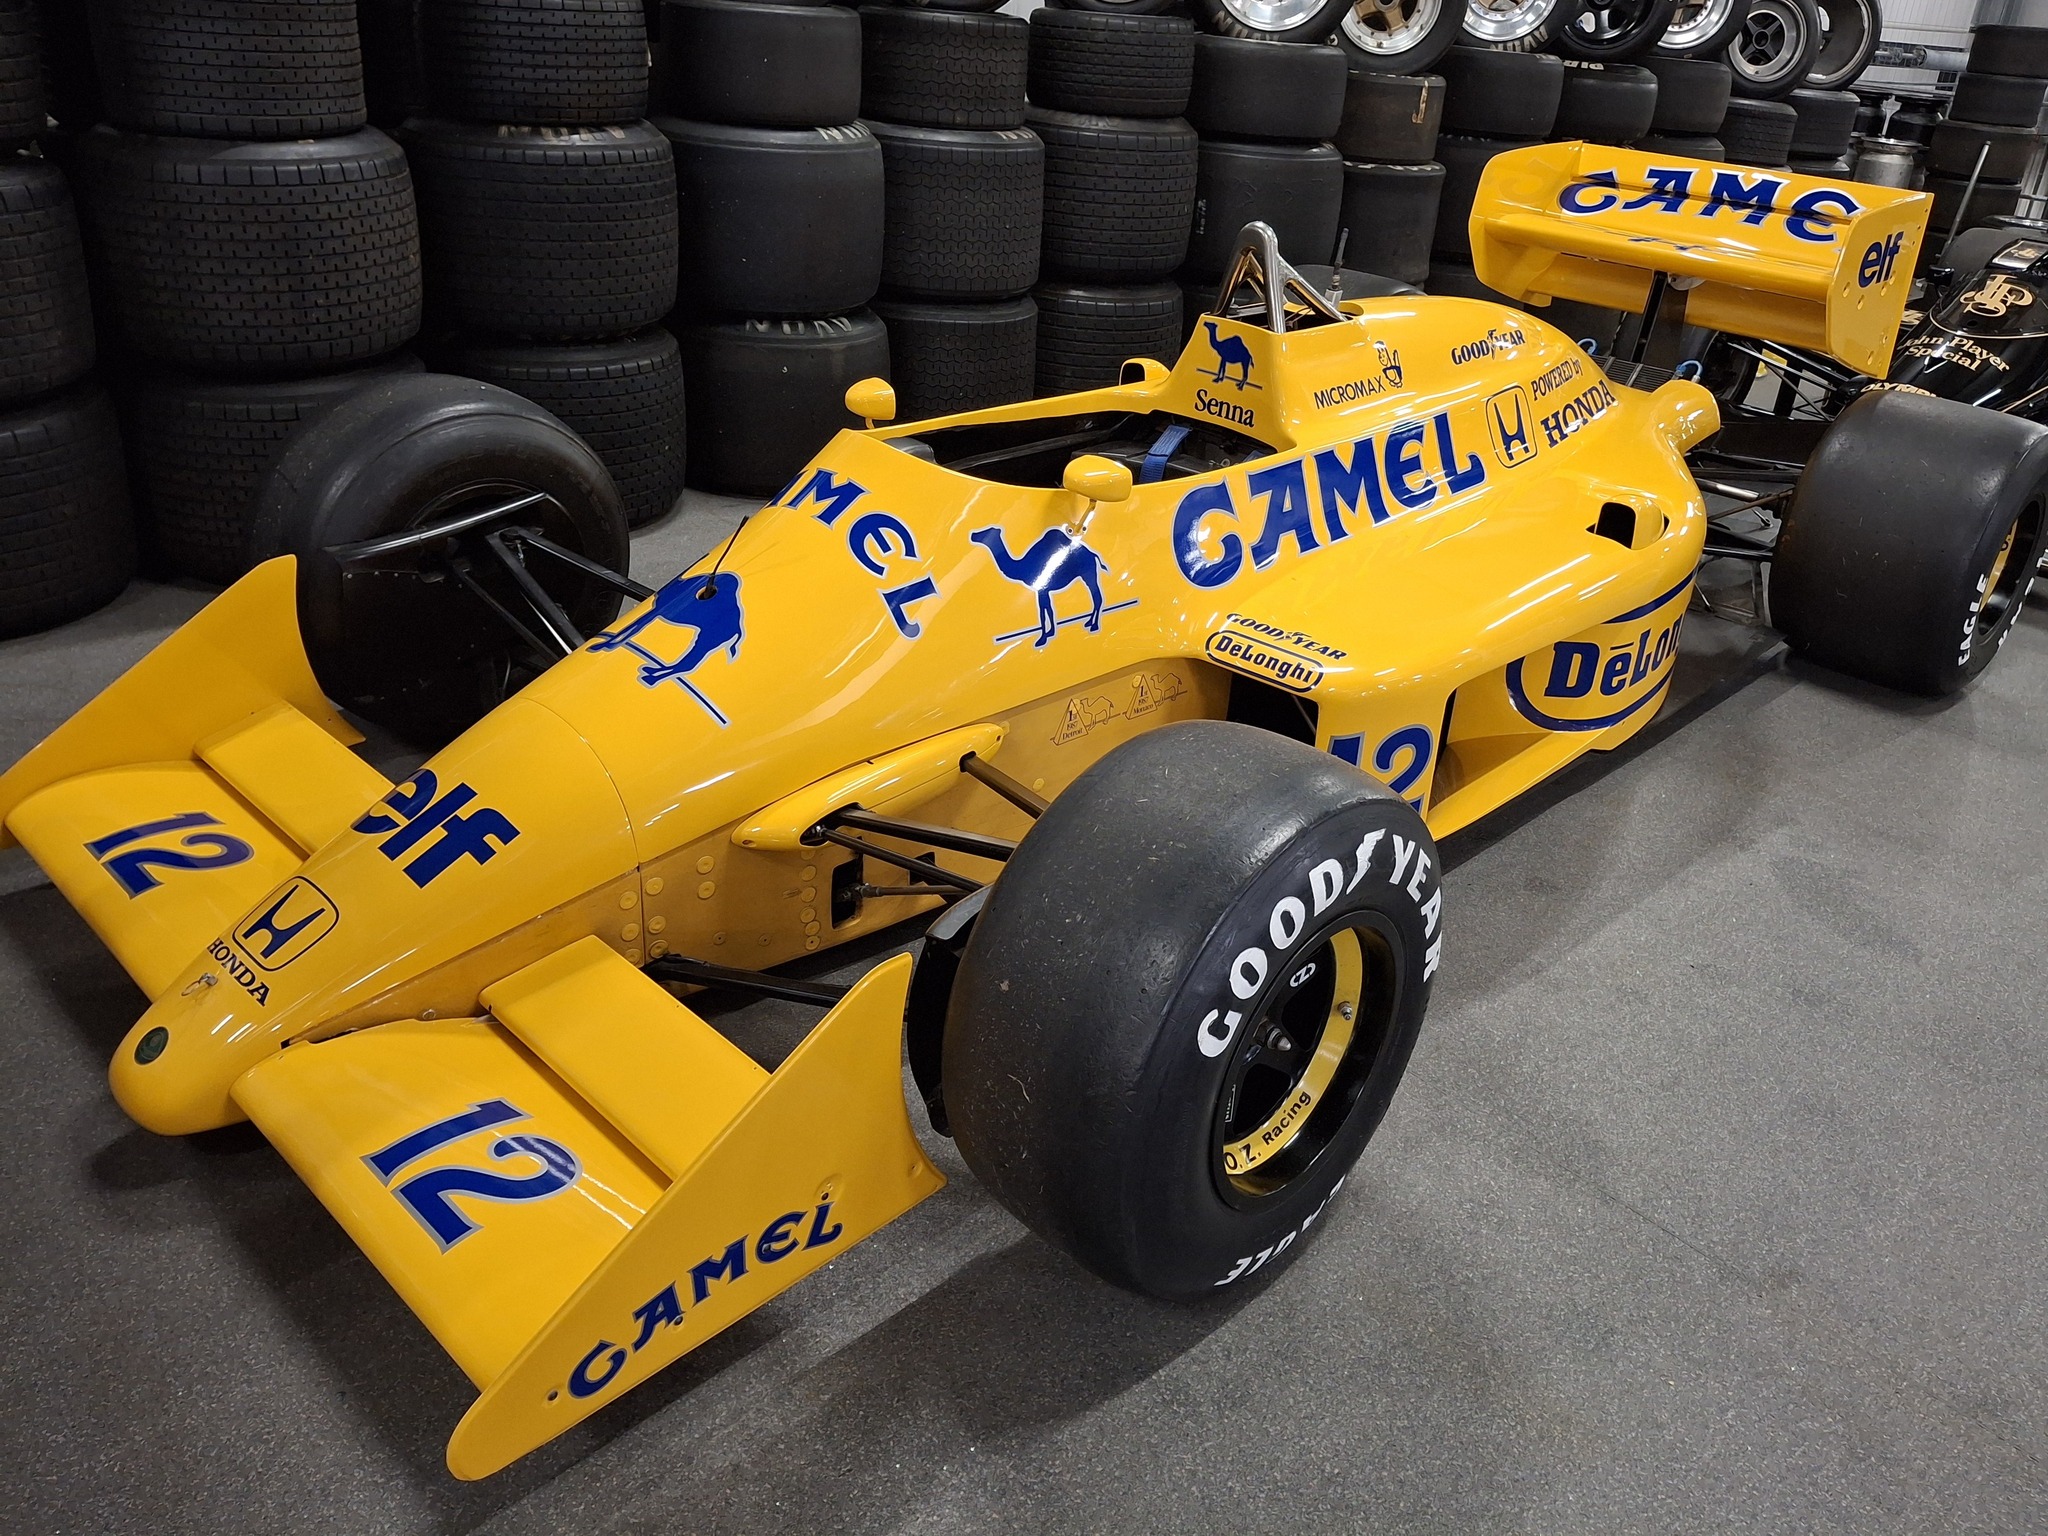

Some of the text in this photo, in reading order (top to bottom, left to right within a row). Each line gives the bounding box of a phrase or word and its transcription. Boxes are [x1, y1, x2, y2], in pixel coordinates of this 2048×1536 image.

[1558, 166, 1864, 243] CAME
[1858, 231, 1905, 288] elf
[1451, 329, 1526, 365] GOODYEAR
[1530, 358, 1584, 401] POWERED by
[1948, 336, 2010, 372] Player
[1194, 388, 1255, 428] Senna
[1313, 375, 1386, 409] MICROMAX
[1540, 379, 1617, 448] HONDA
[1170, 411, 1487, 590] CAMEL
[765, 468, 940, 638] MEL
[1225, 613, 1347, 660] GOODYEAR
[83, 812, 254, 899] 12
[350, 768, 521, 890] elf
[206, 936, 271, 1006] HONDA
[1197, 828, 1442, 1058] GOODYEAR
[1223, 1143, 1261, 1171] O.Z.
[1262, 1091, 1312, 1145] Racing
[360, 1097, 581, 1254] 12
[567, 1201, 844, 1399] CAMEL
